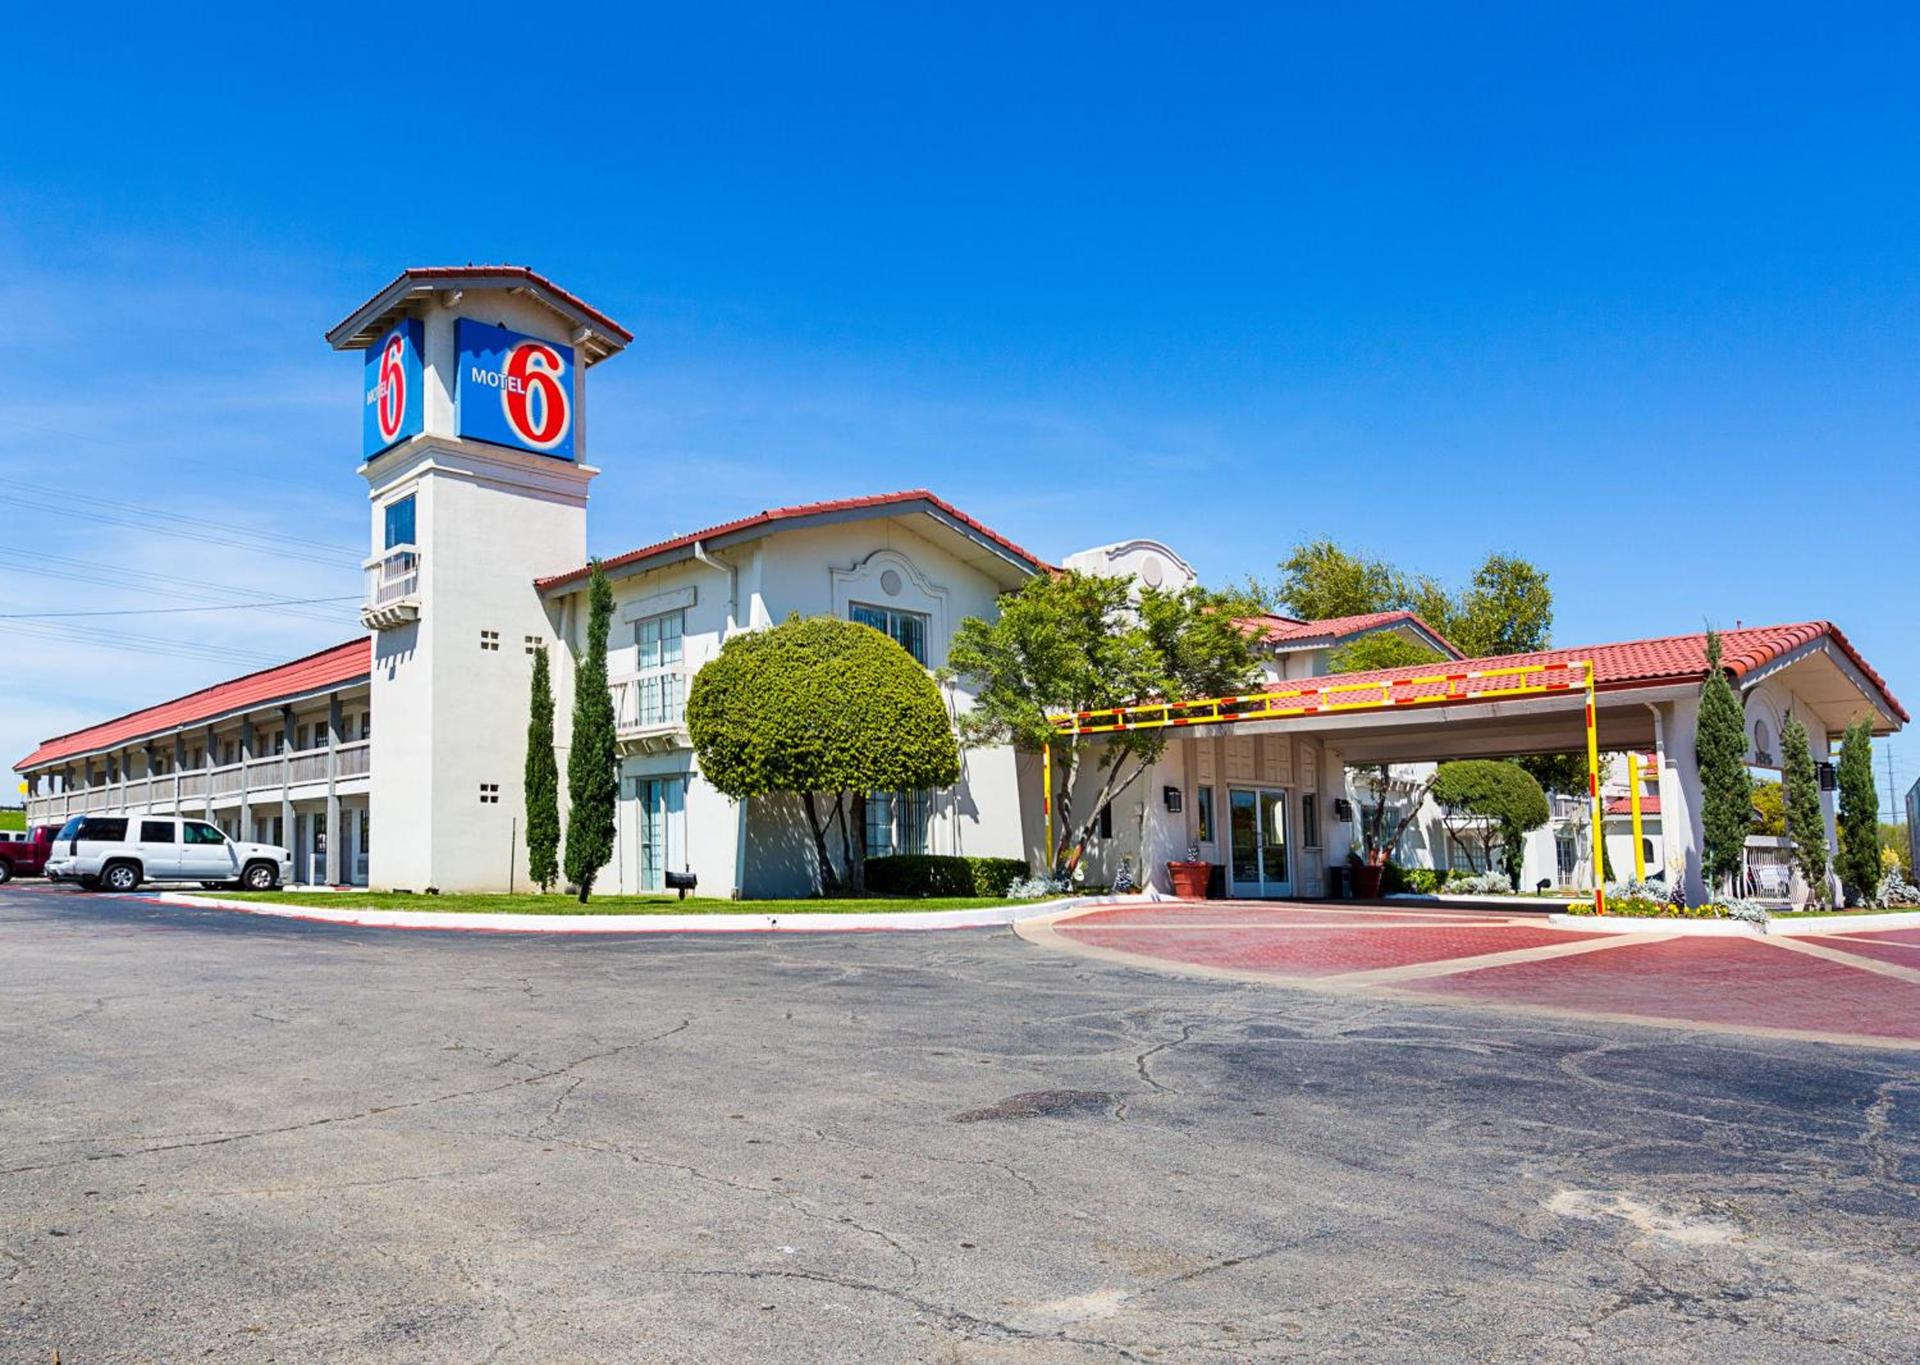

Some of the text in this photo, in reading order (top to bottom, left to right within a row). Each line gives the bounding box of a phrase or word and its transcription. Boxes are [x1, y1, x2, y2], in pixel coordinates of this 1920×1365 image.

[378, 333, 405, 443] 6
[472, 342, 569, 448] MOTEL 6
